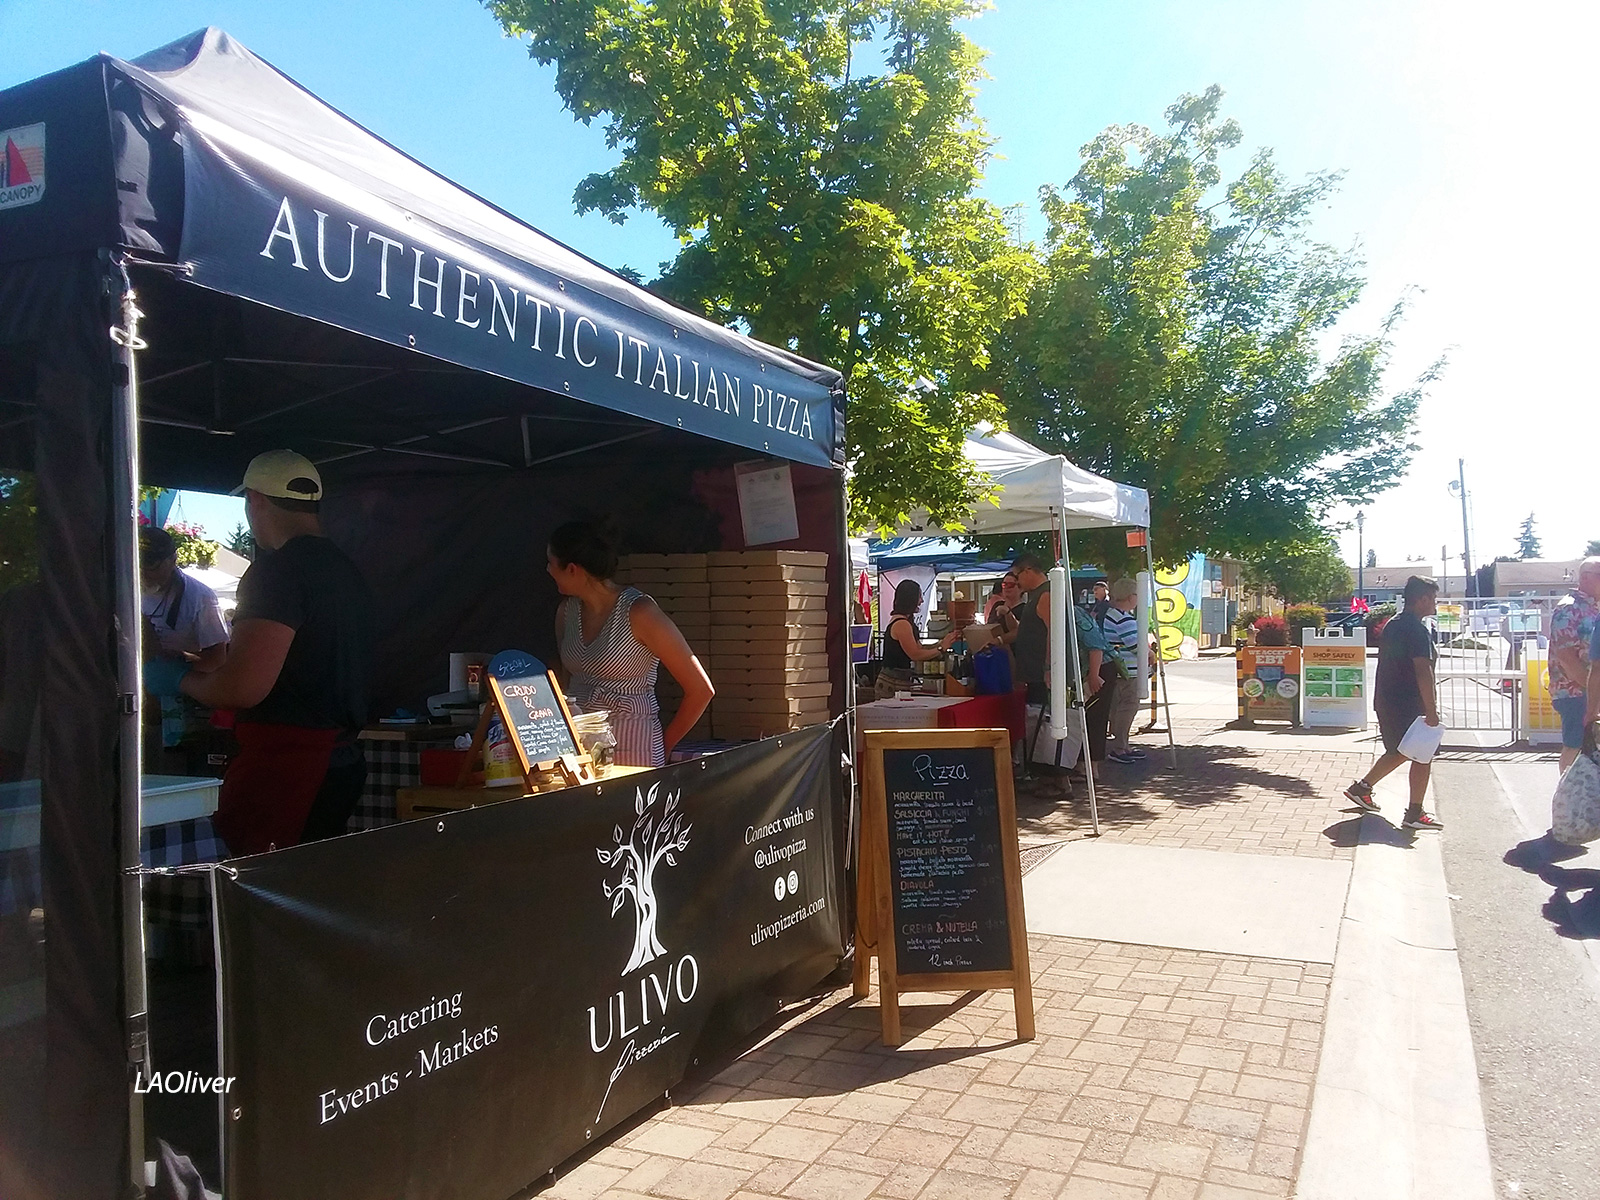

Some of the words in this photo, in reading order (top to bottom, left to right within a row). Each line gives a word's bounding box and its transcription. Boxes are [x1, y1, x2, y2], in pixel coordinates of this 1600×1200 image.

[0, 184, 42, 203] CANOPY
[259, 195, 599, 368] AUTHENTIC
[613, 329, 742, 417] ITALIAN
[752, 383, 815, 441] PIZZA
[1255, 655, 1285, 664] EBT
[503, 685, 537, 697] CRUDO
[522, 695, 535, 709] &
[528, 707, 554, 721] GRANA
[912, 754, 970, 781] Pizza
[892, 791, 946, 801] MARGHERITA
[893, 809, 933, 820] SALSICCIA
[745, 818, 783, 845] Connect
[782, 806, 804, 831] with
[805, 808, 815, 820] us
[754, 838, 807, 869] @ulivopizza
[896, 847, 938, 858] PISTACHIO
[939, 845, 968, 856] PESTO
[900, 880, 934, 891] DIAVOLA
[750, 897, 826, 947] ulivopizzeria.com
[902, 923, 934, 936] CREMA
[935, 921, 944, 933] &
[945, 920, 978, 933] NUTELLA
[928, 953, 942, 967] 12
[586, 954, 699, 1053] ULIVO
[365, 990, 463, 1046] Catering
[319, 1070, 400, 1126] Events
[405, 1069, 413, 1080] -
[418, 1023, 500, 1079] Markets
